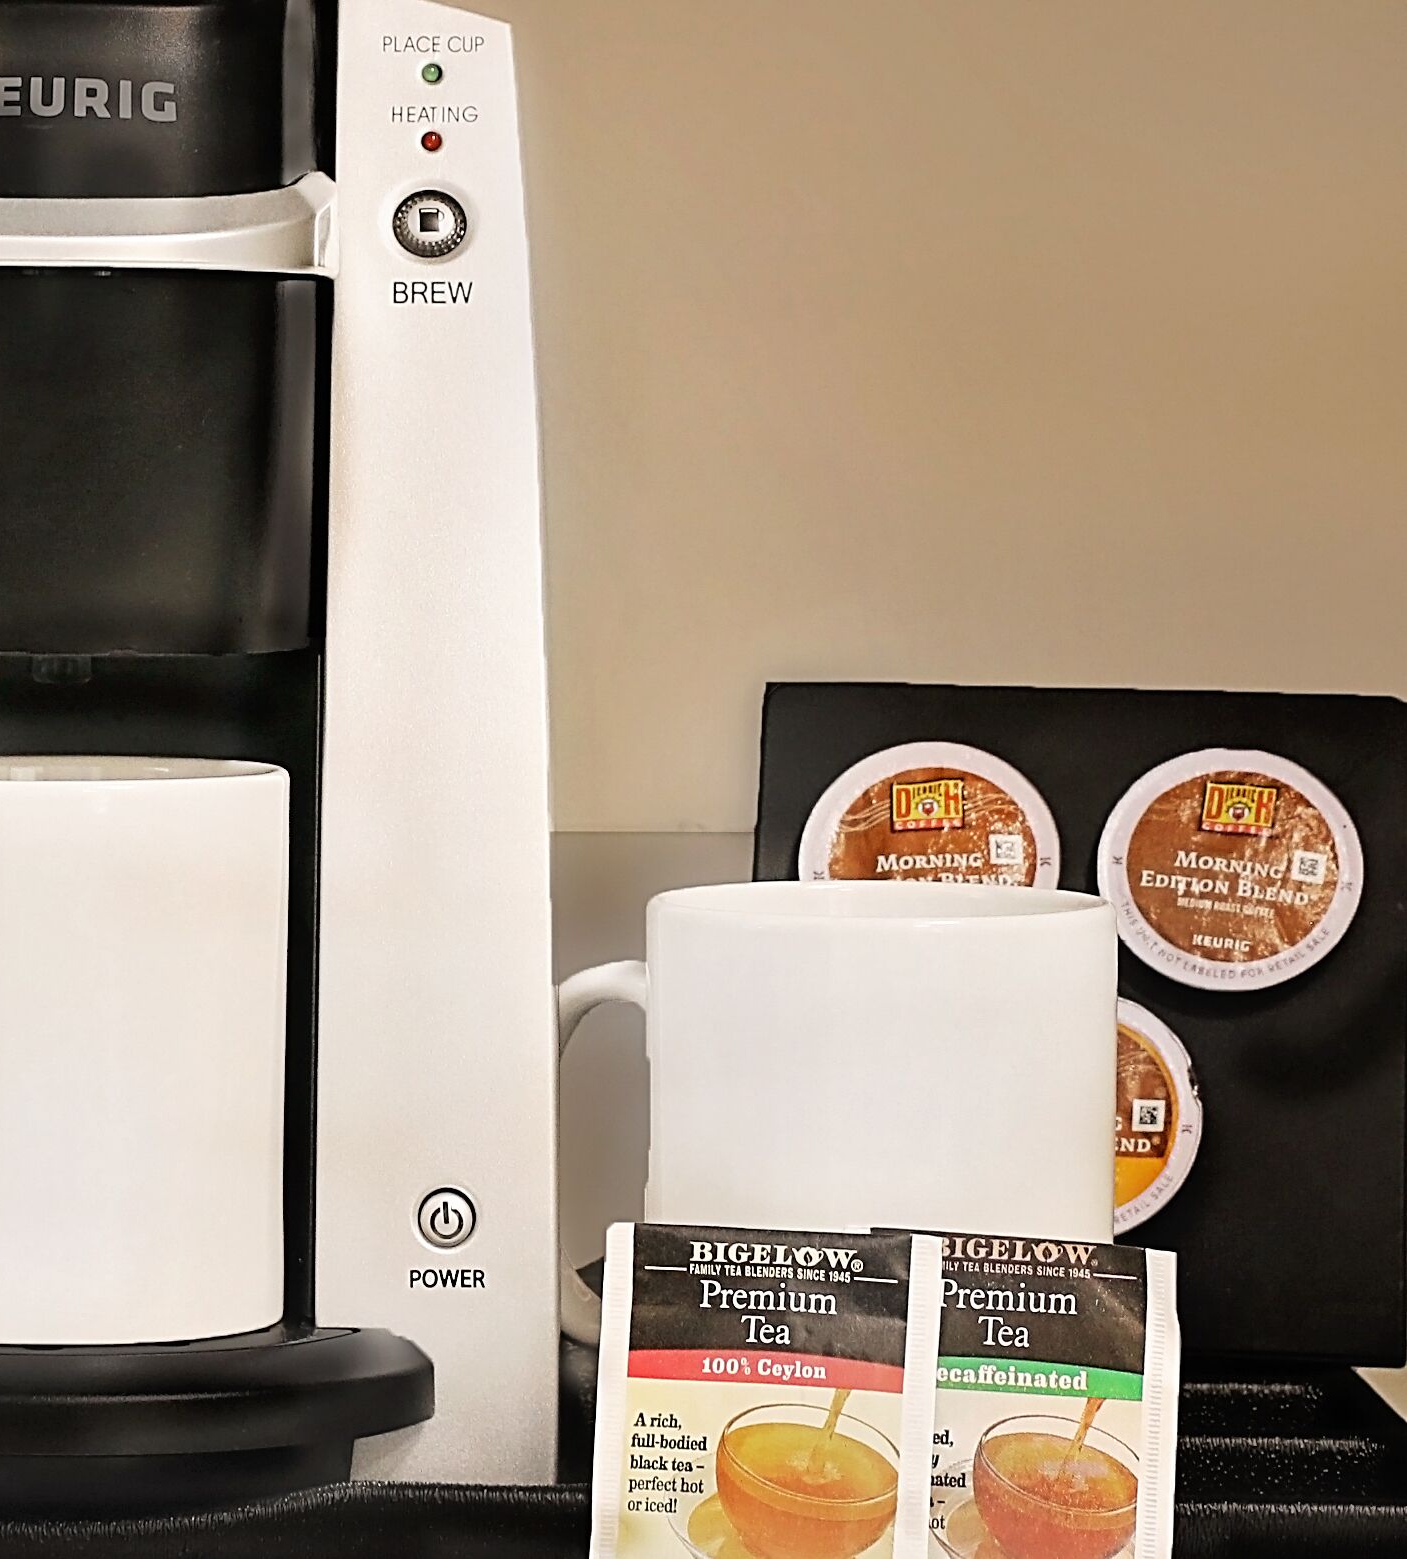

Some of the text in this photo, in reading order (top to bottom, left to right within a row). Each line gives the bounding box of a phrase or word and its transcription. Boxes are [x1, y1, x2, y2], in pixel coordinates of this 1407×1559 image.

[383, 36, 485, 52] PLACE CUP
[391, 106, 478, 122] HEATING
[393, 282, 473, 304] BREW
[1192, 934, 1251, 952] KEURIG
[409, 1269, 486, 1288] POWER
[690, 1263, 851, 1284] FAMILY TEA BLENDERS SINCE 1945
[962, 1261, 980, 1272] TEA
[983, 1262, 1033, 1276] BLENDERS
[1037, 1265, 1065, 1278] SINCE
[1068, 1268, 1091, 1279] 1945
[699, 1279, 838, 1315] Premium
[940, 1278, 1078, 1315] Premium
[741, 1315, 791, 1345] Tea
[977, 1315, 1030, 1348] Tea
[702, 1357, 827, 1380] 100% Ceylon
[937, 1364, 1089, 1391] ecaffeinated
[633, 1412, 682, 1431] A rich,
[630, 1433, 708, 1451] full-bodied
[630, 1454, 669, 1471] black
[672, 1458, 693, 1472] tea
[628, 1475, 704, 1494] perfect hot
[627, 1497, 678, 1513] or iced!
